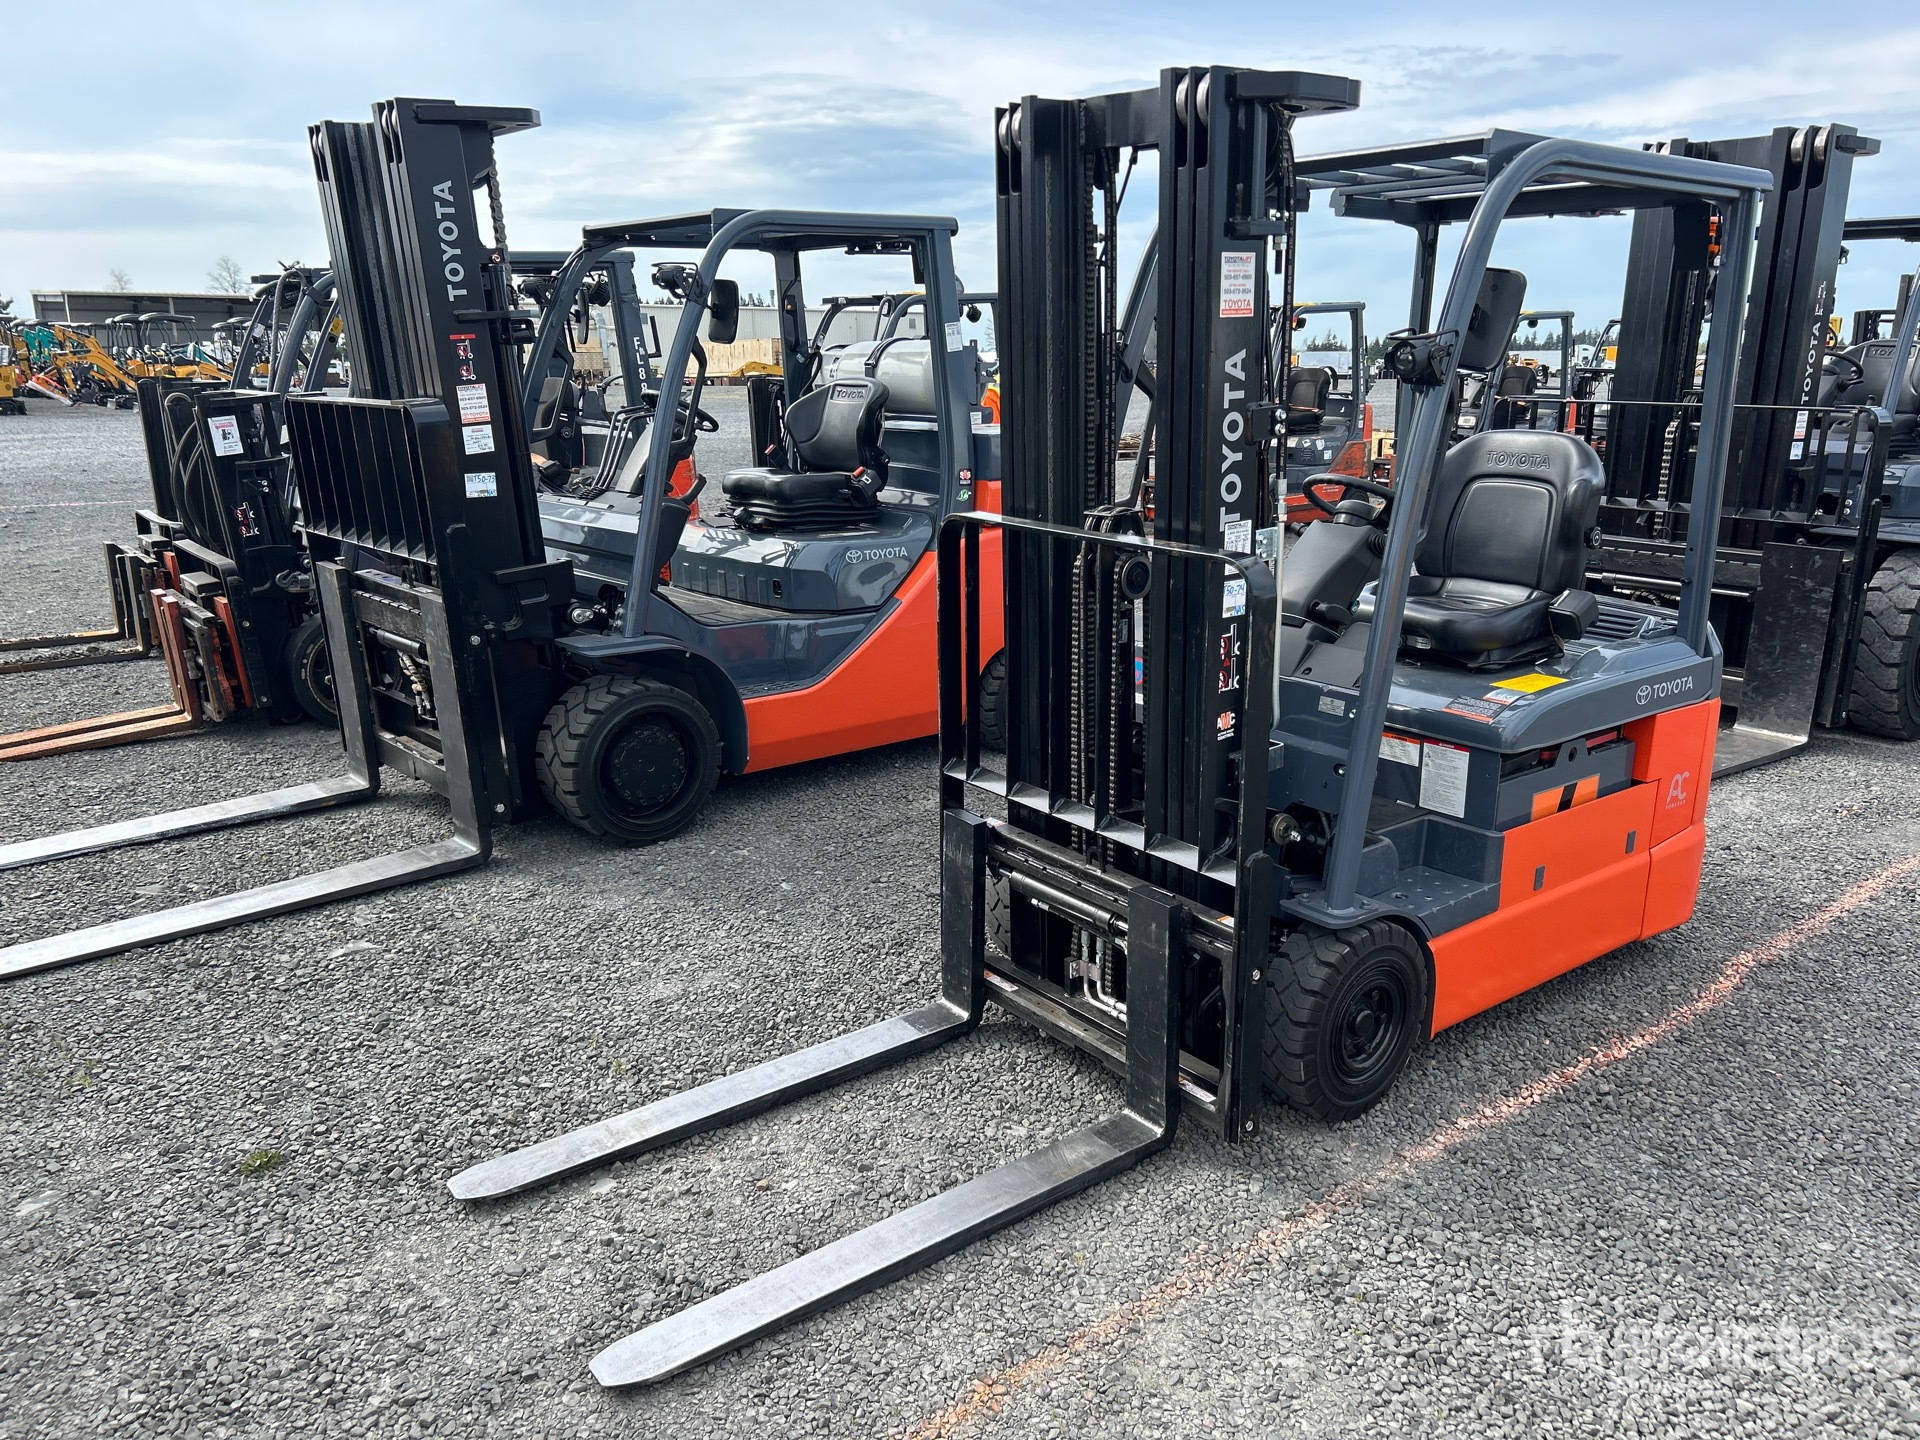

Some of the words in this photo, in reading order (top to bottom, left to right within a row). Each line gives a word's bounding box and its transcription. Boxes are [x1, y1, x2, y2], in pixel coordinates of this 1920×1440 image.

[433, 179, 468, 302] TOYOTA
[1223, 299, 1251, 308] TOYOTA
[1800, 321, 1821, 405] TOYOTA
[836, 389, 865, 399] TOYOTA
[1219, 348, 1250, 532] TOYOTA
[1486, 450, 1551, 470] TOYOTA
[864, 547, 908, 561] TOYOTA
[1653, 676, 1693, 699] TOYOTA
[1217, 711, 1235, 730] AMC
